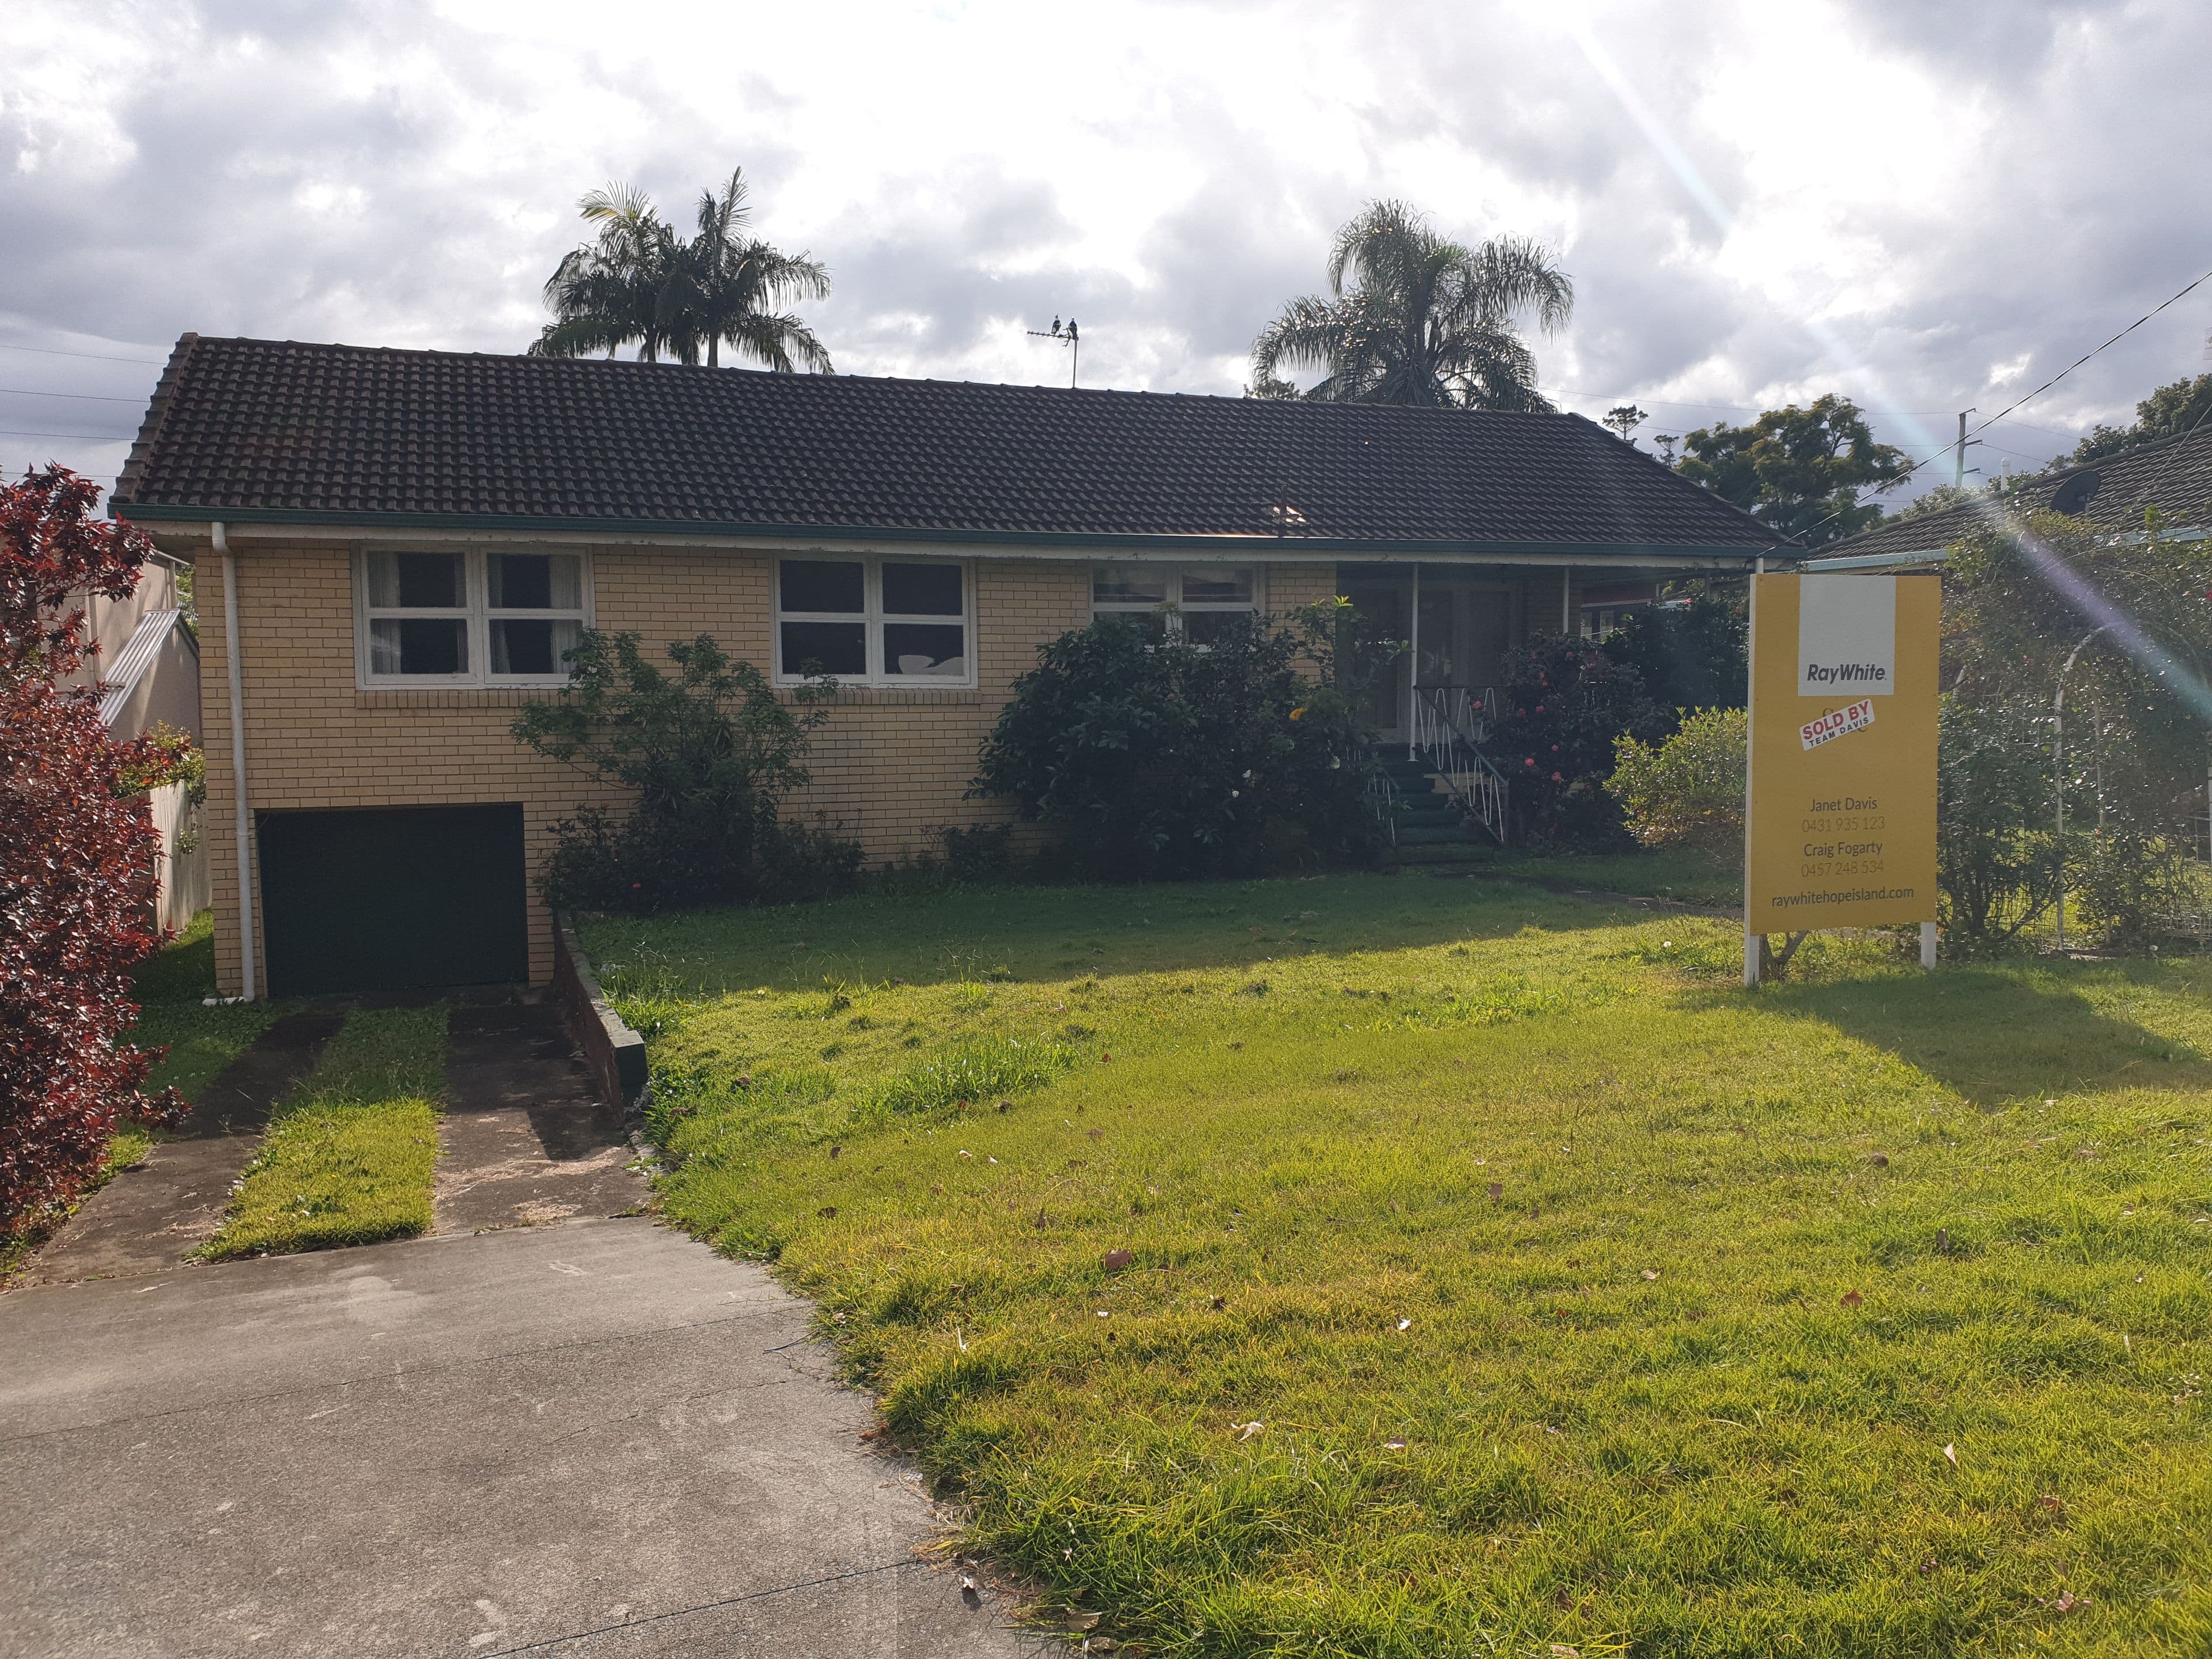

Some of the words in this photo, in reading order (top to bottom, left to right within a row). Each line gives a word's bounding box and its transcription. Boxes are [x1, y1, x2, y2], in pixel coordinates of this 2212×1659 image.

[1802, 713, 1844, 740] SOLD
[1848, 700, 1869, 721] BY
[1809, 732, 1835, 747] TEAM
[1840, 717, 1869, 734] DAVIS
[1810, 799, 1841, 812] Janet
[1846, 797, 1877, 810] Davis
[1802, 819, 1831, 832] 0431
[1836, 817, 1858, 831] 935
[1863, 816, 1885, 830] 123
[1804, 843, 1834, 858] Craig
[1838, 842, 1883, 857] Fogarty
[1801, 863, 1832, 877] 0457
[1772, 887, 1914, 908] raywhitehopeisland.com
